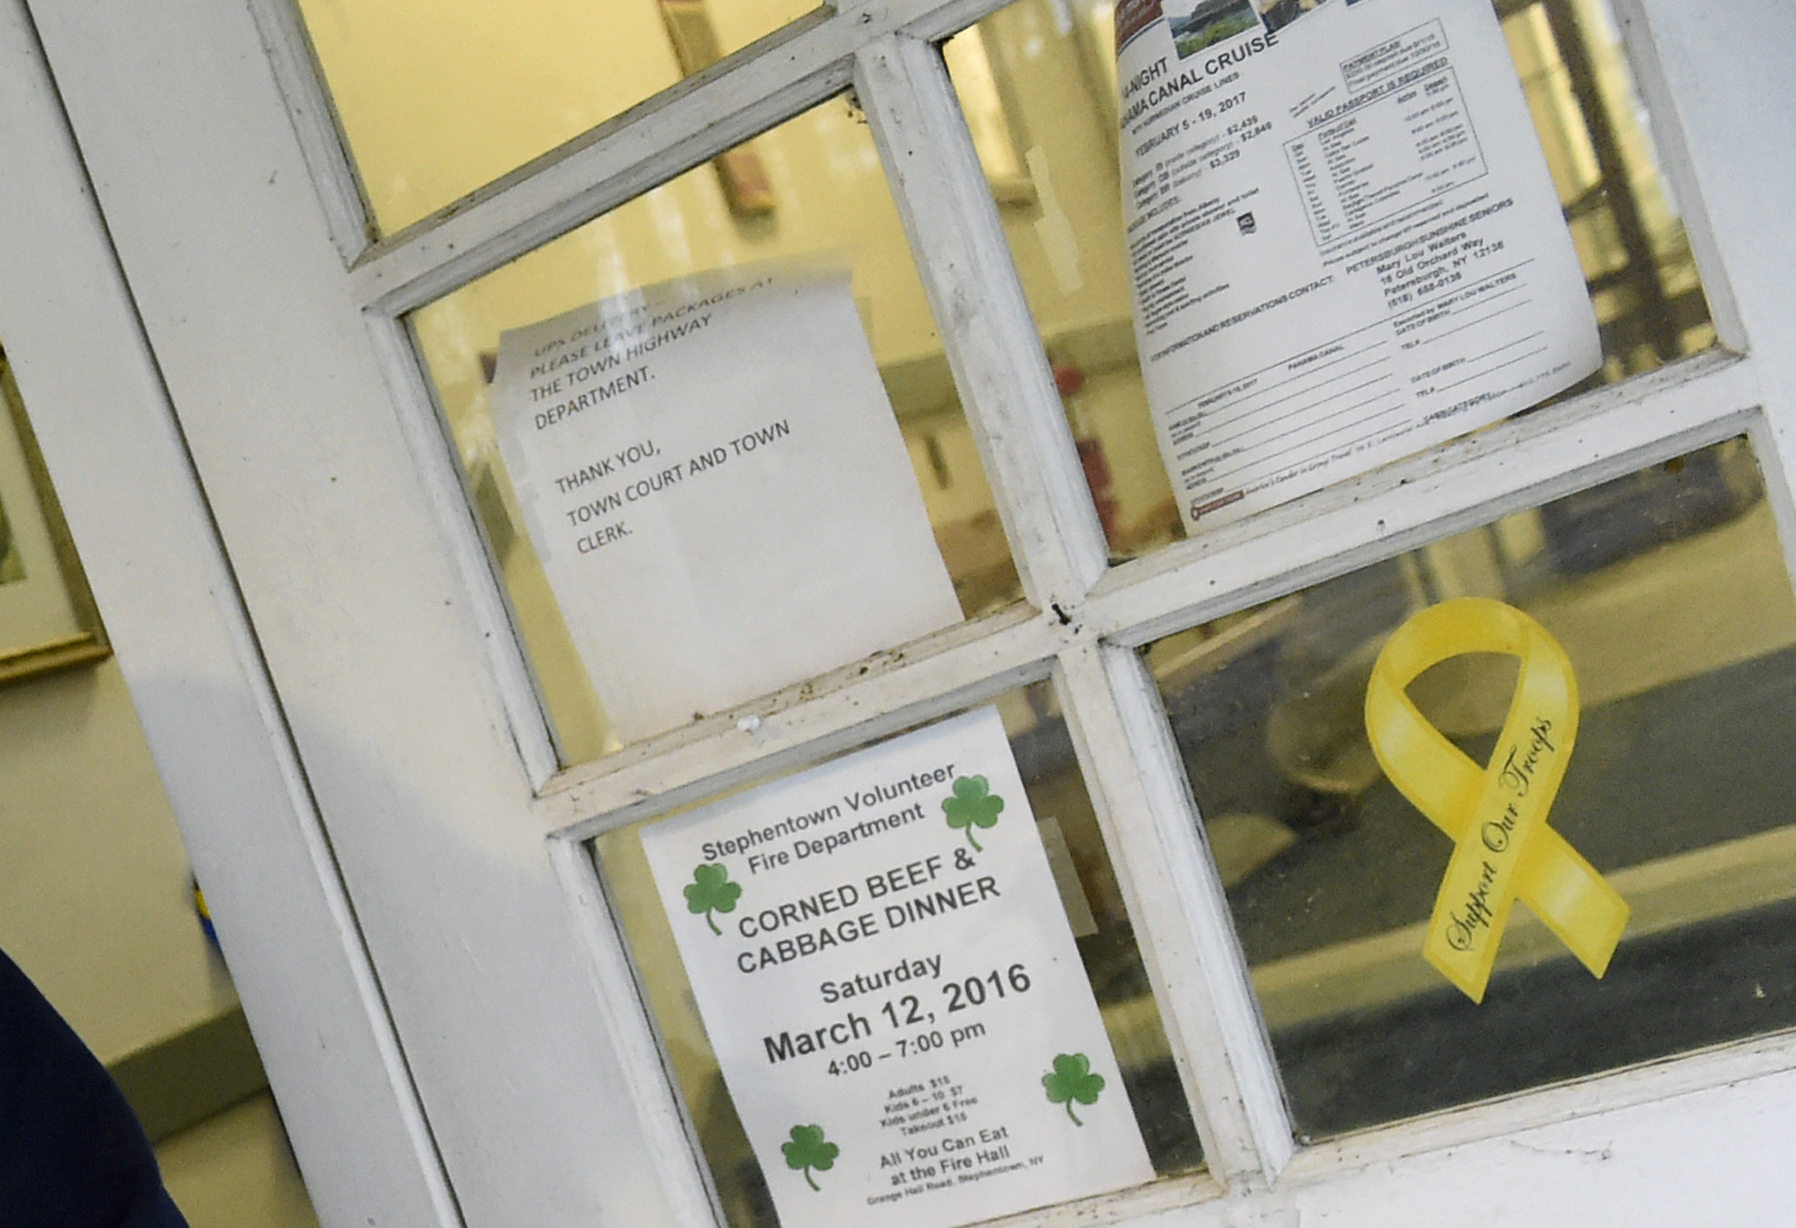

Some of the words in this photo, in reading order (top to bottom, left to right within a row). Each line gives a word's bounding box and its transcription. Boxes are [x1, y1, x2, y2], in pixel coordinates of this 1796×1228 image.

[1148, 65, 1203, 107] CANAL
[1204, 31, 1280, 77] CRUISE
[1181, 83, 1212, 105] CRUISE
[1213, 71, 1239, 89] LINES
[1306, 107, 1335, 128] VALID
[1336, 85, 1385, 115] PASSPORT
[1385, 79, 1396, 91] IS
[1397, 55, 1448, 86] REQUIRED
[1181, 118, 1189, 131] 5
[1198, 105, 1217, 123] 19,
[1218, 91, 1247, 114] 2017
[1345, 237, 1420, 275] PETERSBURGH
[1418, 216, 1470, 244] SUNSHINE
[1468, 197, 1514, 223] SENIORS
[1376, 258, 1401, 276] Mary
[1404, 248, 1425, 263] Lou
[1428, 230, 1467, 253] Walters
[1395, 265, 1413, 279] Old
[1416, 247, 1458, 270] Orchard
[1460, 236, 1485, 254] Way
[1452, 255, 1467, 268] NY
[528, 344, 588, 378] PLEASE
[593, 322, 644, 353] LEAVE
[651, 285, 744, 327] PACKAGES
[1220, 293, 1288, 329] RESERVATIONS
[529, 377, 562, 403] THE
[566, 353, 620, 387] TOWN
[625, 313, 712, 361] HIGHWAY
[534, 363, 655, 431] DEPARTMENT.
[555, 456, 614, 496] THANK
[615, 436, 661, 470] YOU,
[566, 490, 622, 530] TOWN
[624, 463, 683, 504] COURT
[687, 444, 727, 478] AND
[729, 417, 789, 458] TOWN
[576, 516, 632, 556] CLERK.
[1498, 716, 1554, 798] Troops
[700, 799, 842, 865] Stephentown
[843, 759, 958, 813] Volunteer
[747, 846, 791, 875] Fire
[792, 800, 927, 863] Department
[1481, 801, 1520, 854] Our
[736, 882, 860, 940] CORNED
[865, 855, 947, 899] BEEF
[950, 845, 976, 872] &
[1446, 860, 1498, 952] Support
[735, 912, 880, 975] CABBAGE
[884, 874, 1001, 929] DINNER
[818, 948, 947, 1010] Saturday
[762, 1008, 873, 1064] March
[879, 990, 937, 1035] 12,
[940, 961, 1033, 1013] 2016
[824, 1049, 874, 1078] 4:00
[895, 1029, 945, 1058] 7:00
[949, 1021, 988, 1048] pm
[879, 1114, 906, 1128] Kids
[907, 1104, 941, 1121] under
[952, 1095, 978, 1109] Free
[884, 1099, 910, 1114] Kids
[931, 1090, 946, 1101] 10
[950, 1084, 964, 1097] $7
[887, 1081, 925, 1100] Adults
[877, 1151, 902, 1169] All
[904, 1142, 939, 1162] You
[940, 1132, 976, 1153] Can
[978, 1124, 1009, 1143] Eat
[900, 1117, 944, 1136] Takeout
[889, 1172, 907, 1186] at
[909, 1164, 937, 1181] the
[939, 1154, 973, 1173] Fire
[976, 1145, 1010, 1164] Hall
[904, 1184, 924, 1196] Hall
[1028, 1154, 1045, 1165] NY
